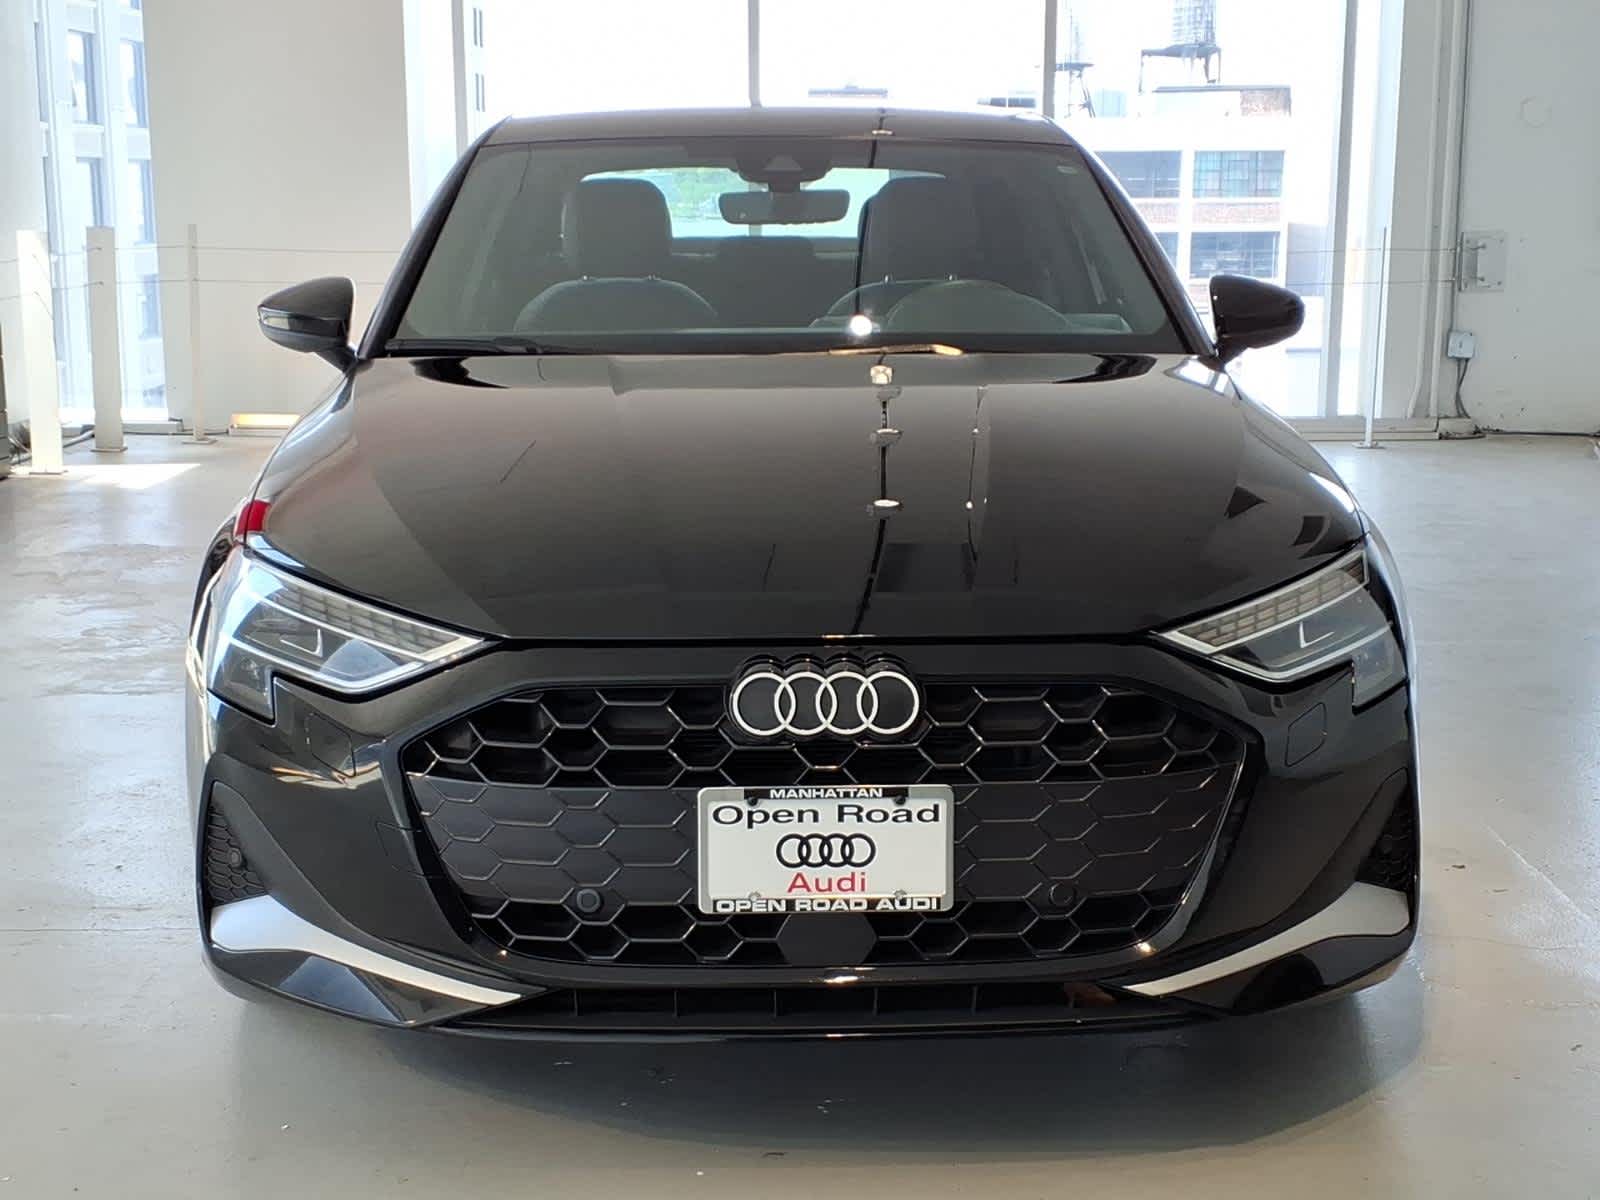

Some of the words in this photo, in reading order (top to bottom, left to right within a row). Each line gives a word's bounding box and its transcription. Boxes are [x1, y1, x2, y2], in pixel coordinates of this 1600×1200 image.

[769, 788, 883, 799] MANHATTAN
[712, 804, 819, 830] Open
[837, 803, 940, 824] Road
[787, 871, 867, 893] Audi
[716, 899, 786, 913] OPEN
[794, 898, 868, 912] ROAD
[876, 896, 937, 910] AUDI
